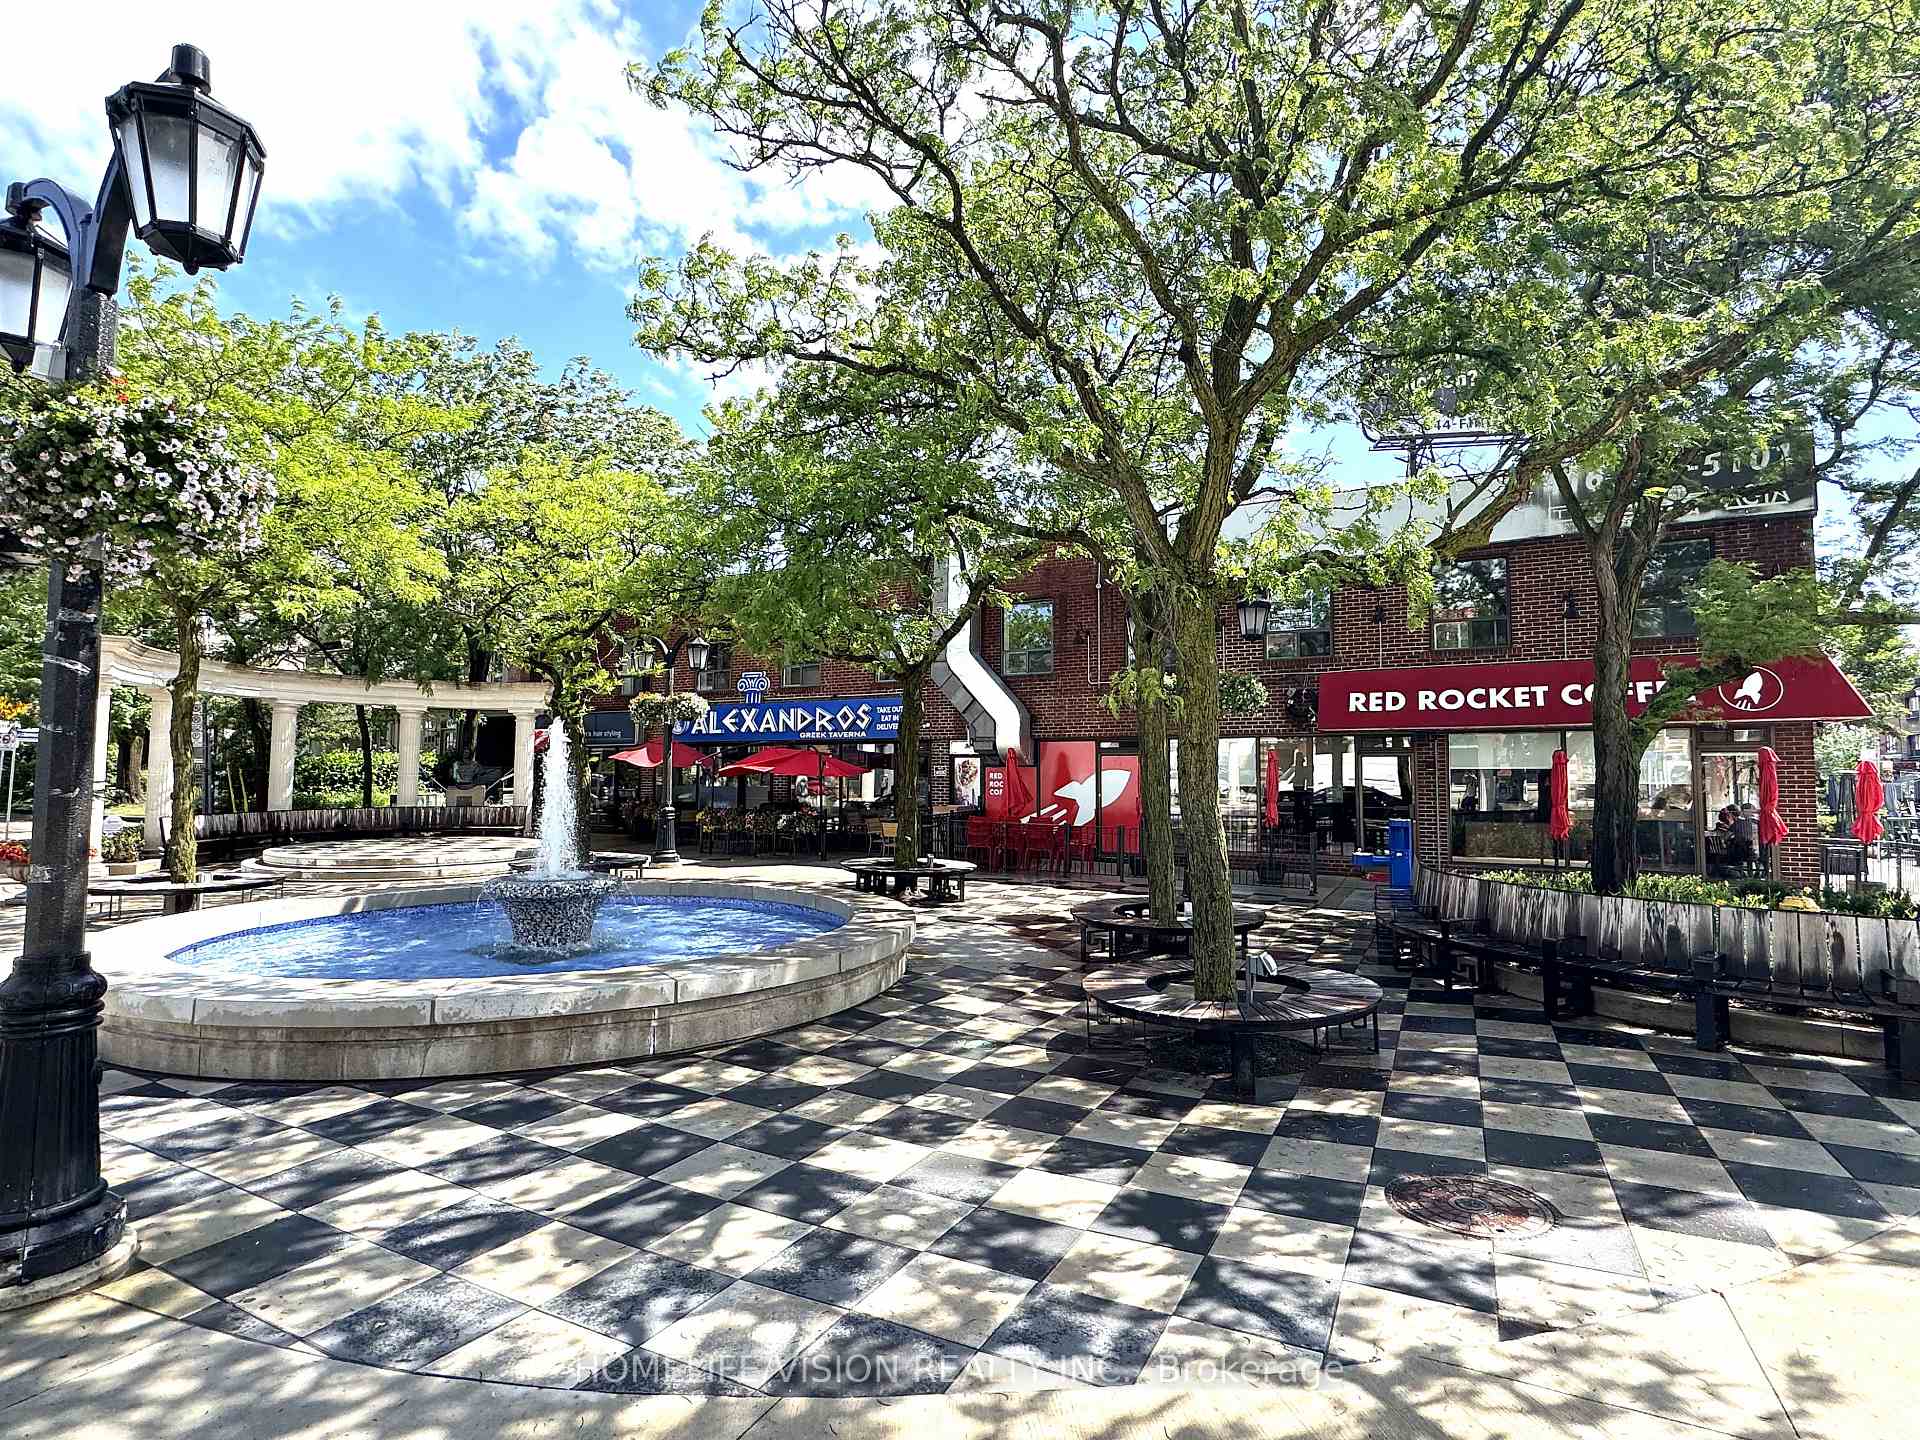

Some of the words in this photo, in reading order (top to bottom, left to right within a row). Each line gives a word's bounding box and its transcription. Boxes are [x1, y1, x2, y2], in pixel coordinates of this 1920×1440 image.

[1349, 691, 1406, 712] RED
[1418, 685, 1550, 711] ROCKET
[892, 705, 904, 713] OUT
[691, 703, 873, 734] ALEXANDROS
[989, 780, 1004, 788] ROC
